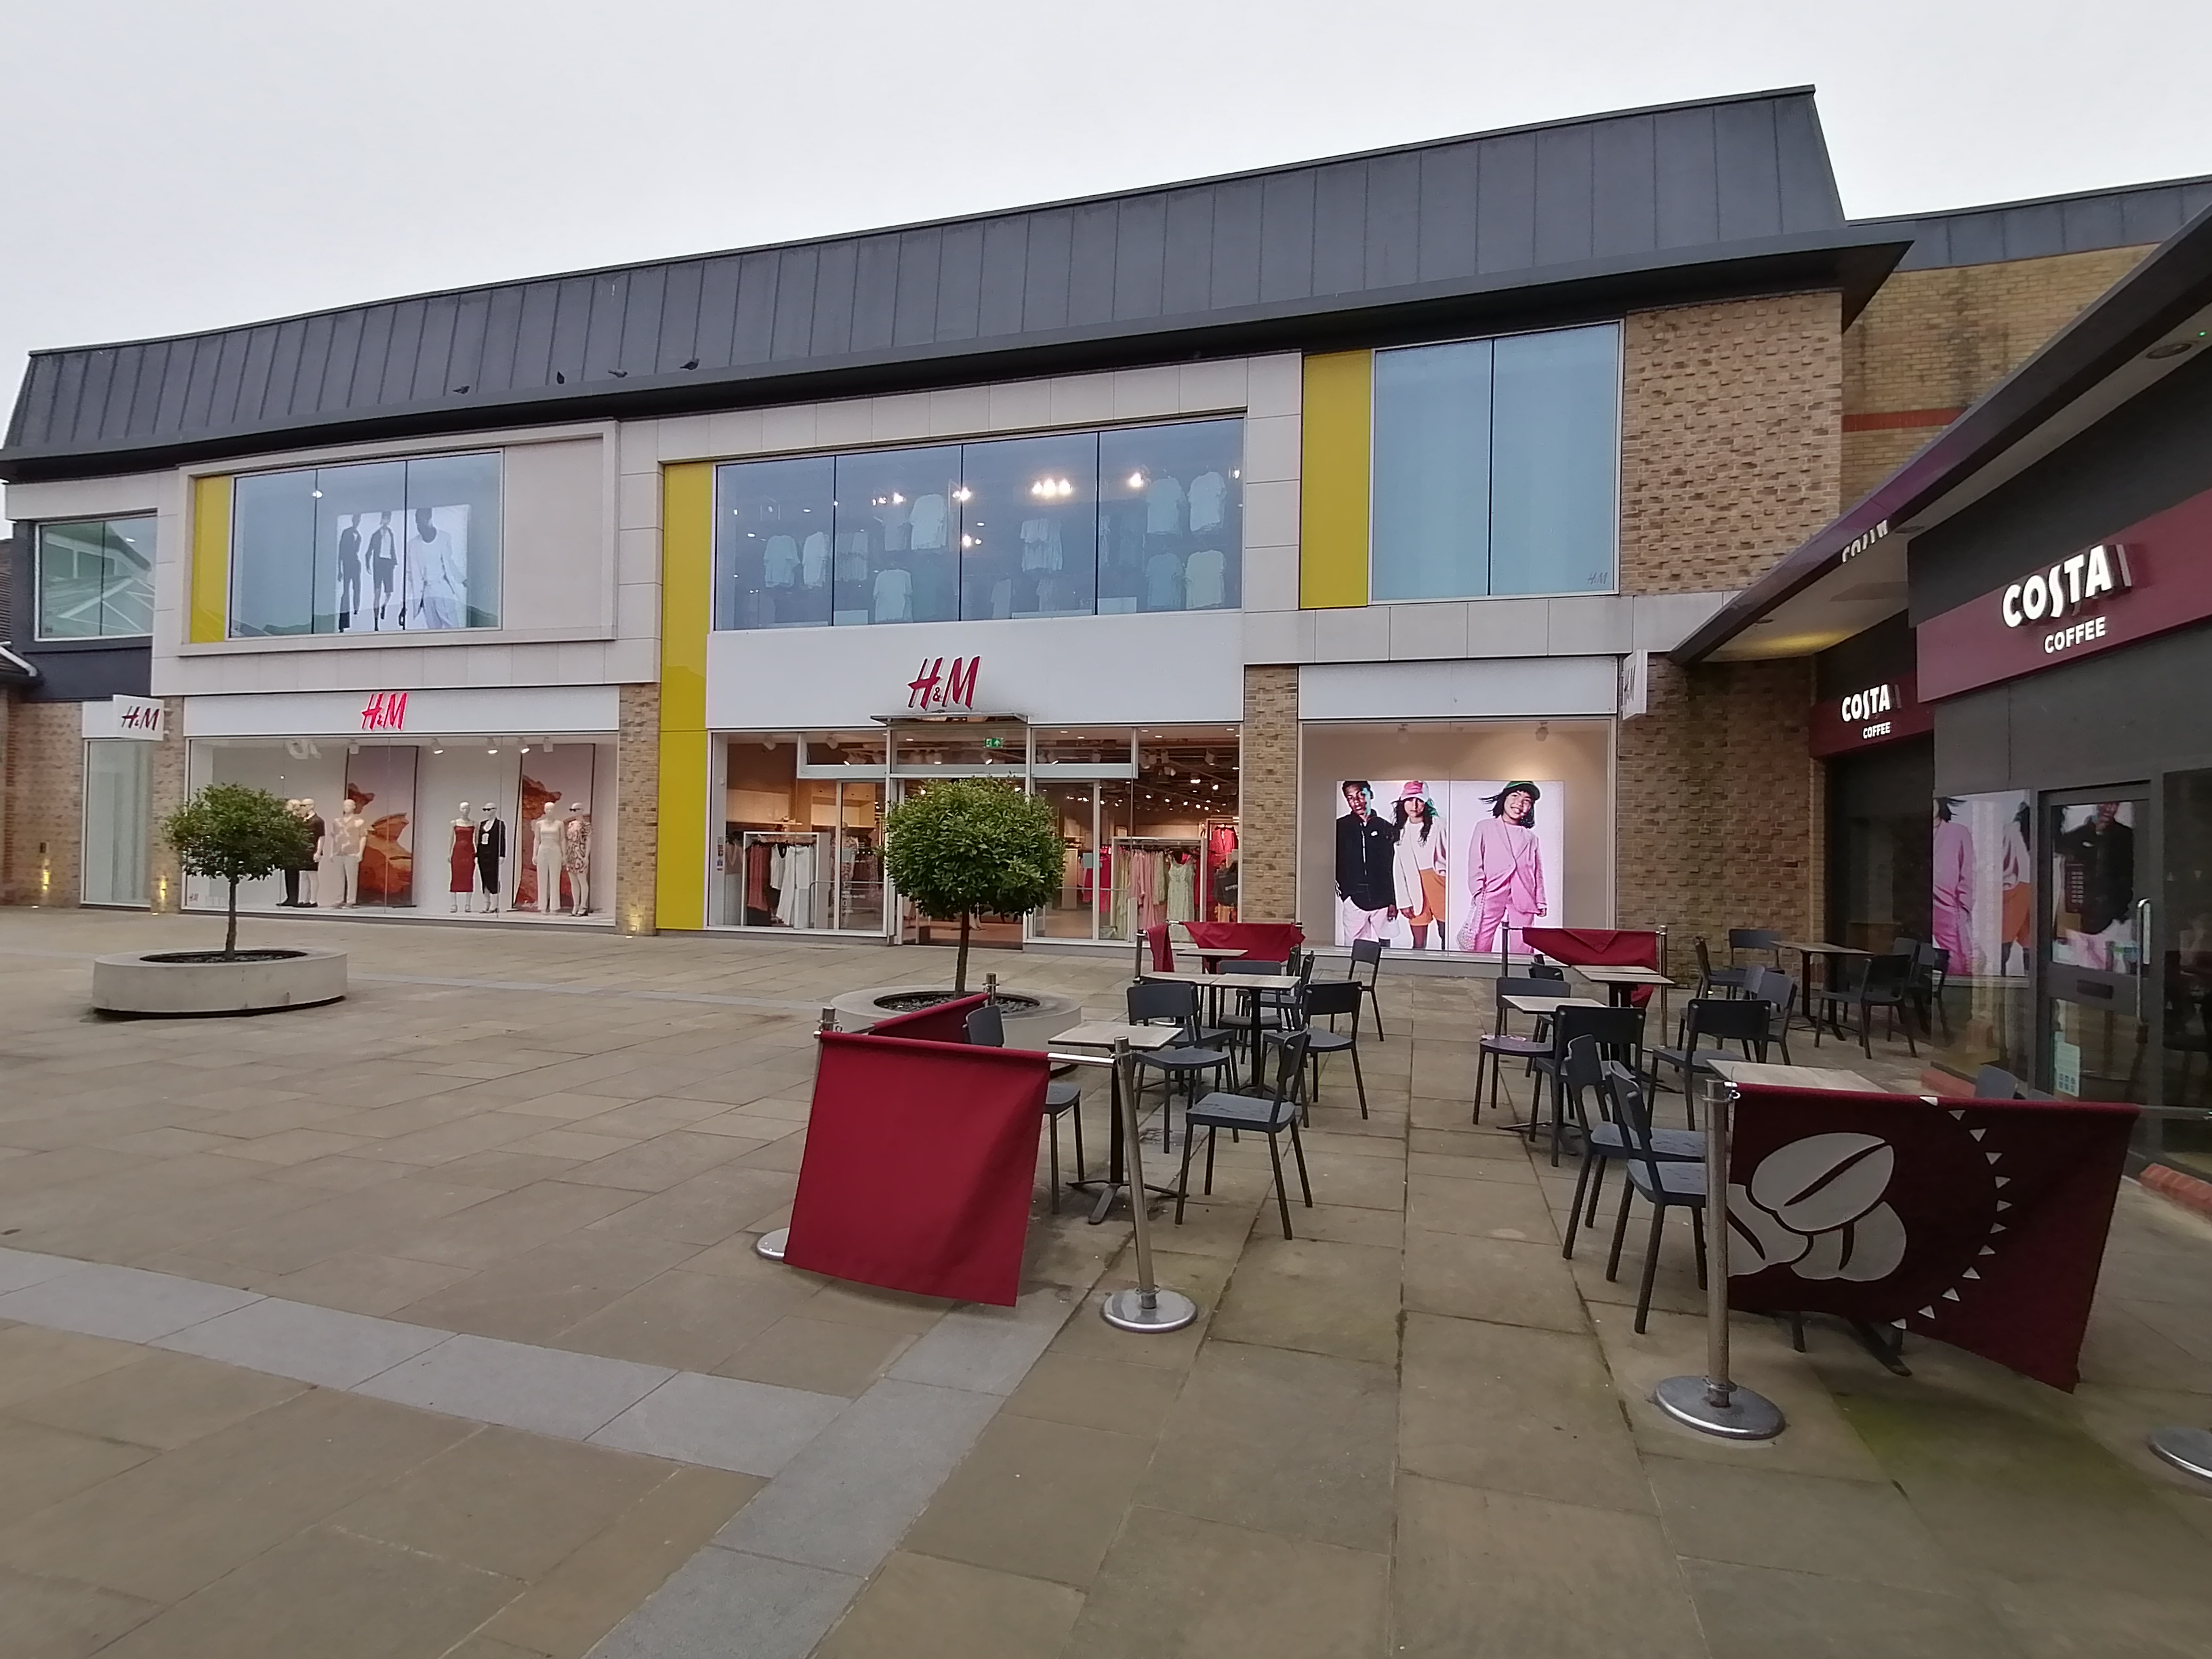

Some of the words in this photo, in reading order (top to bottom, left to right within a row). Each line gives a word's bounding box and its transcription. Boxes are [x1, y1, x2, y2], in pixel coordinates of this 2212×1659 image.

[2002, 544, 2113, 628] COSTA
[2044, 616, 2106, 654] COFFEE
[907, 655, 981, 710] H&M
[121, 705, 160, 731] H&M
[361, 692, 407, 731] H&M
[1841, 684, 1891, 722] COSTA
[1862, 721, 1891, 739] COFFEE
